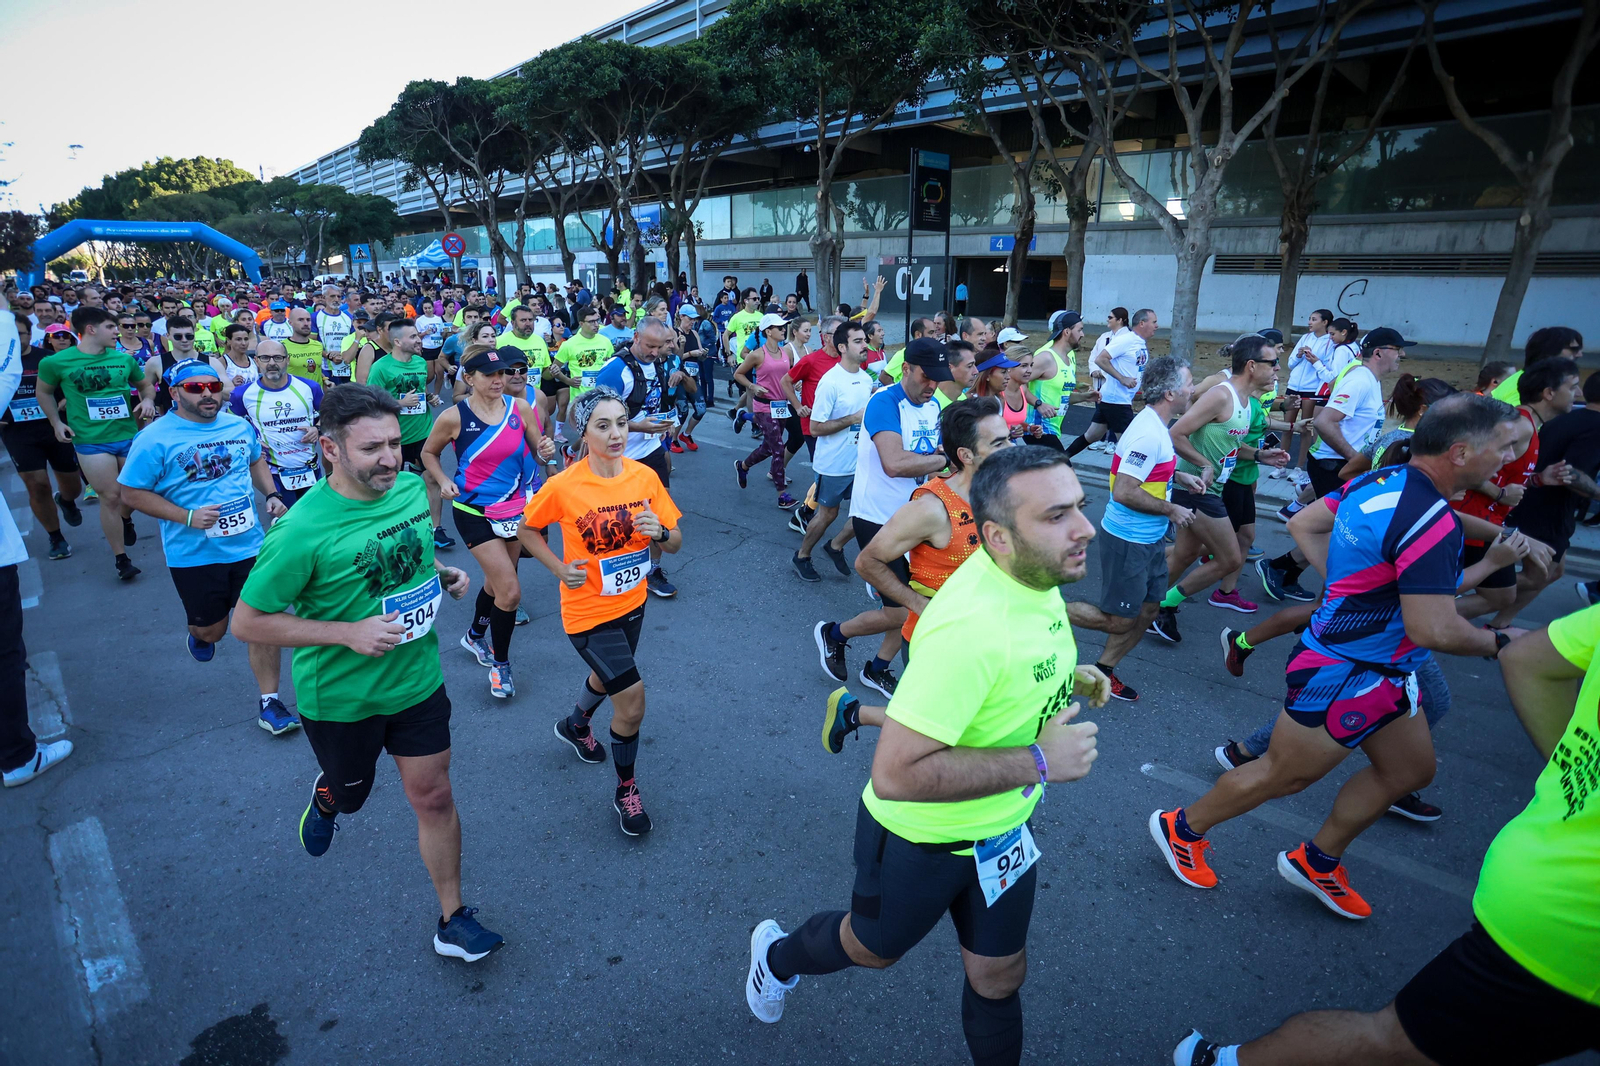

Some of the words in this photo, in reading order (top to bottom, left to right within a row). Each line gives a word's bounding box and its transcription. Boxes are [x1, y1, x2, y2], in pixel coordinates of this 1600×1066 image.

[996, 238, 1004, 250] 4
[895, 266, 932, 301] 04
[21, 407, 40, 416] 451
[98, 406, 120, 415] 568
[263, 416, 307, 427] VETE-RUNNERS
[197, 441, 225, 449] CARRERA
[289, 474, 307, 485] 774
[598, 504, 628, 513] CARRERA
[218, 512, 246, 530] 855
[376, 520, 411, 540] CARRERA
[1343, 526, 1358, 546] Páez
[615, 566, 640, 587] 829
[408, 589, 424, 599] Carrera
[424, 581, 435, 591] Popular
[401, 597, 418, 607] Ciudad
[403, 602, 434, 630] 504
[1033, 661, 1044, 673] THE
[1033, 663, 1056, 683] WOLF
[1559, 742, 1572, 758] ES
